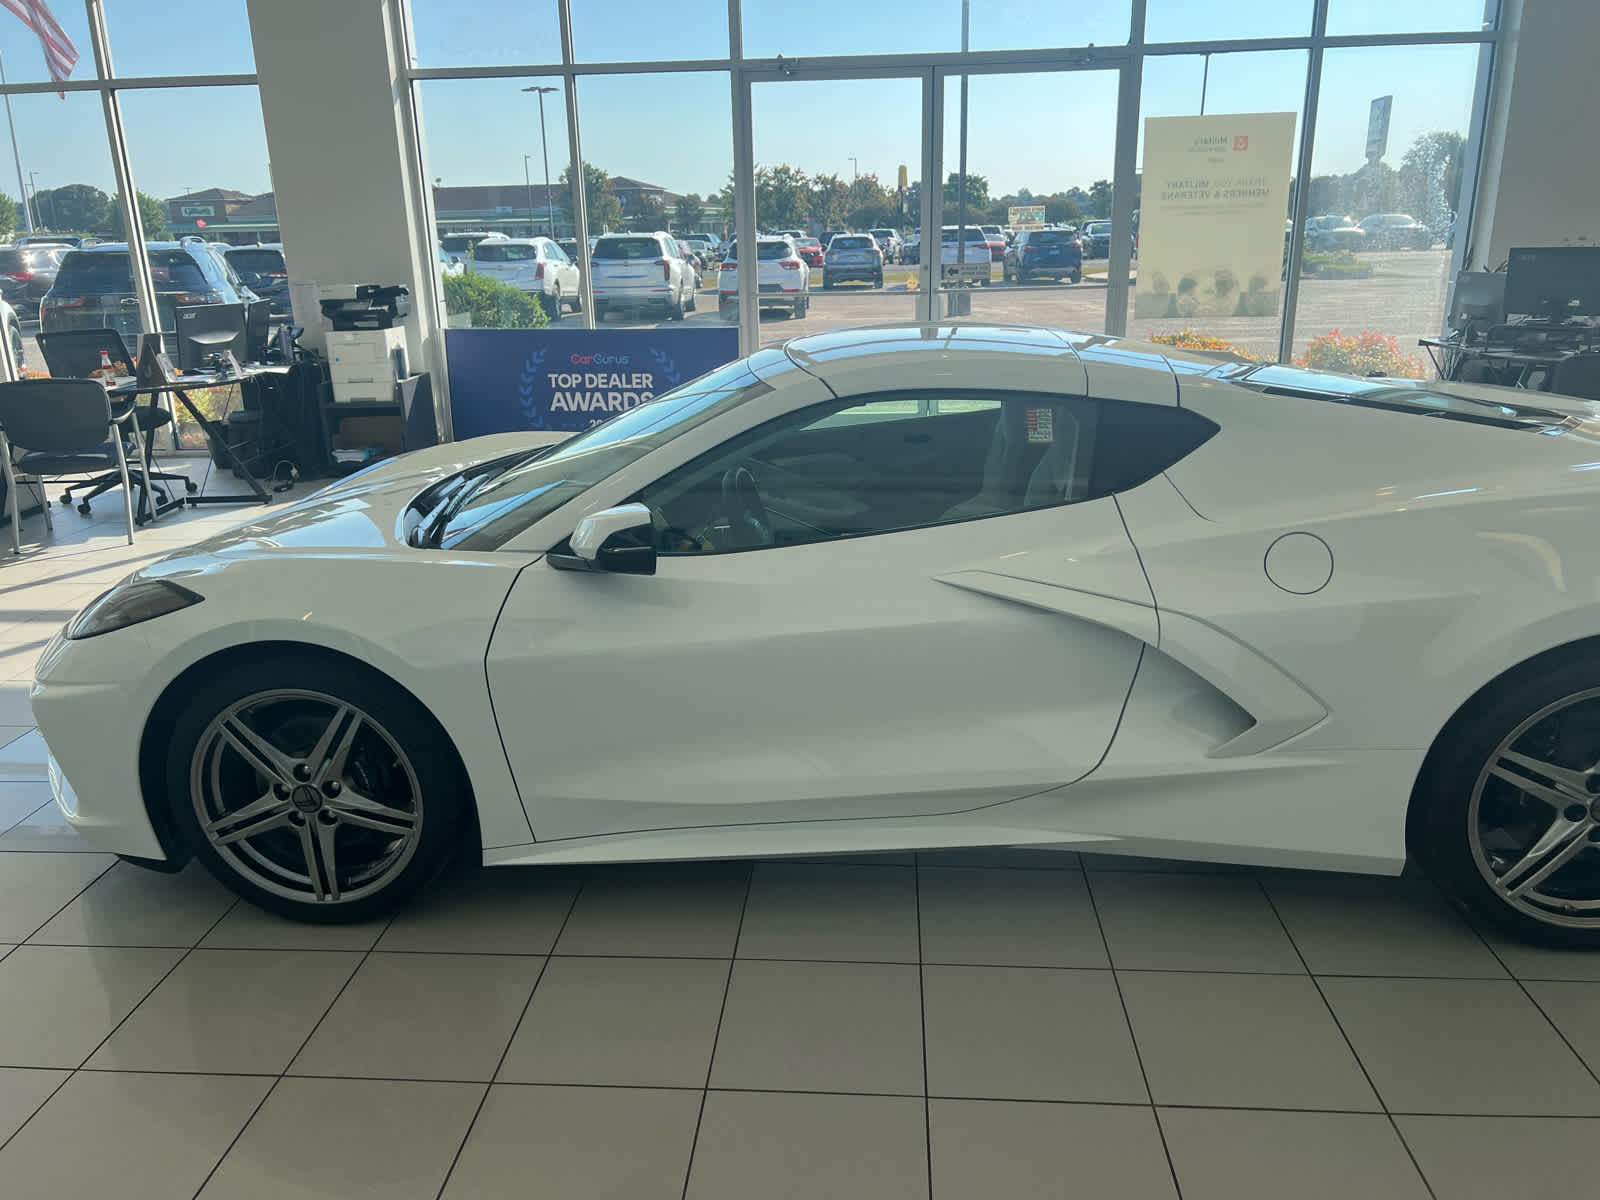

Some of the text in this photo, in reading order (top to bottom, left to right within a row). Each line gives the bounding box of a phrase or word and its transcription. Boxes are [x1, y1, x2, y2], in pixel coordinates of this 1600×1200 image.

[571, 353, 629, 365] CarGurus
[547, 373, 653, 389] TOP DEALER
